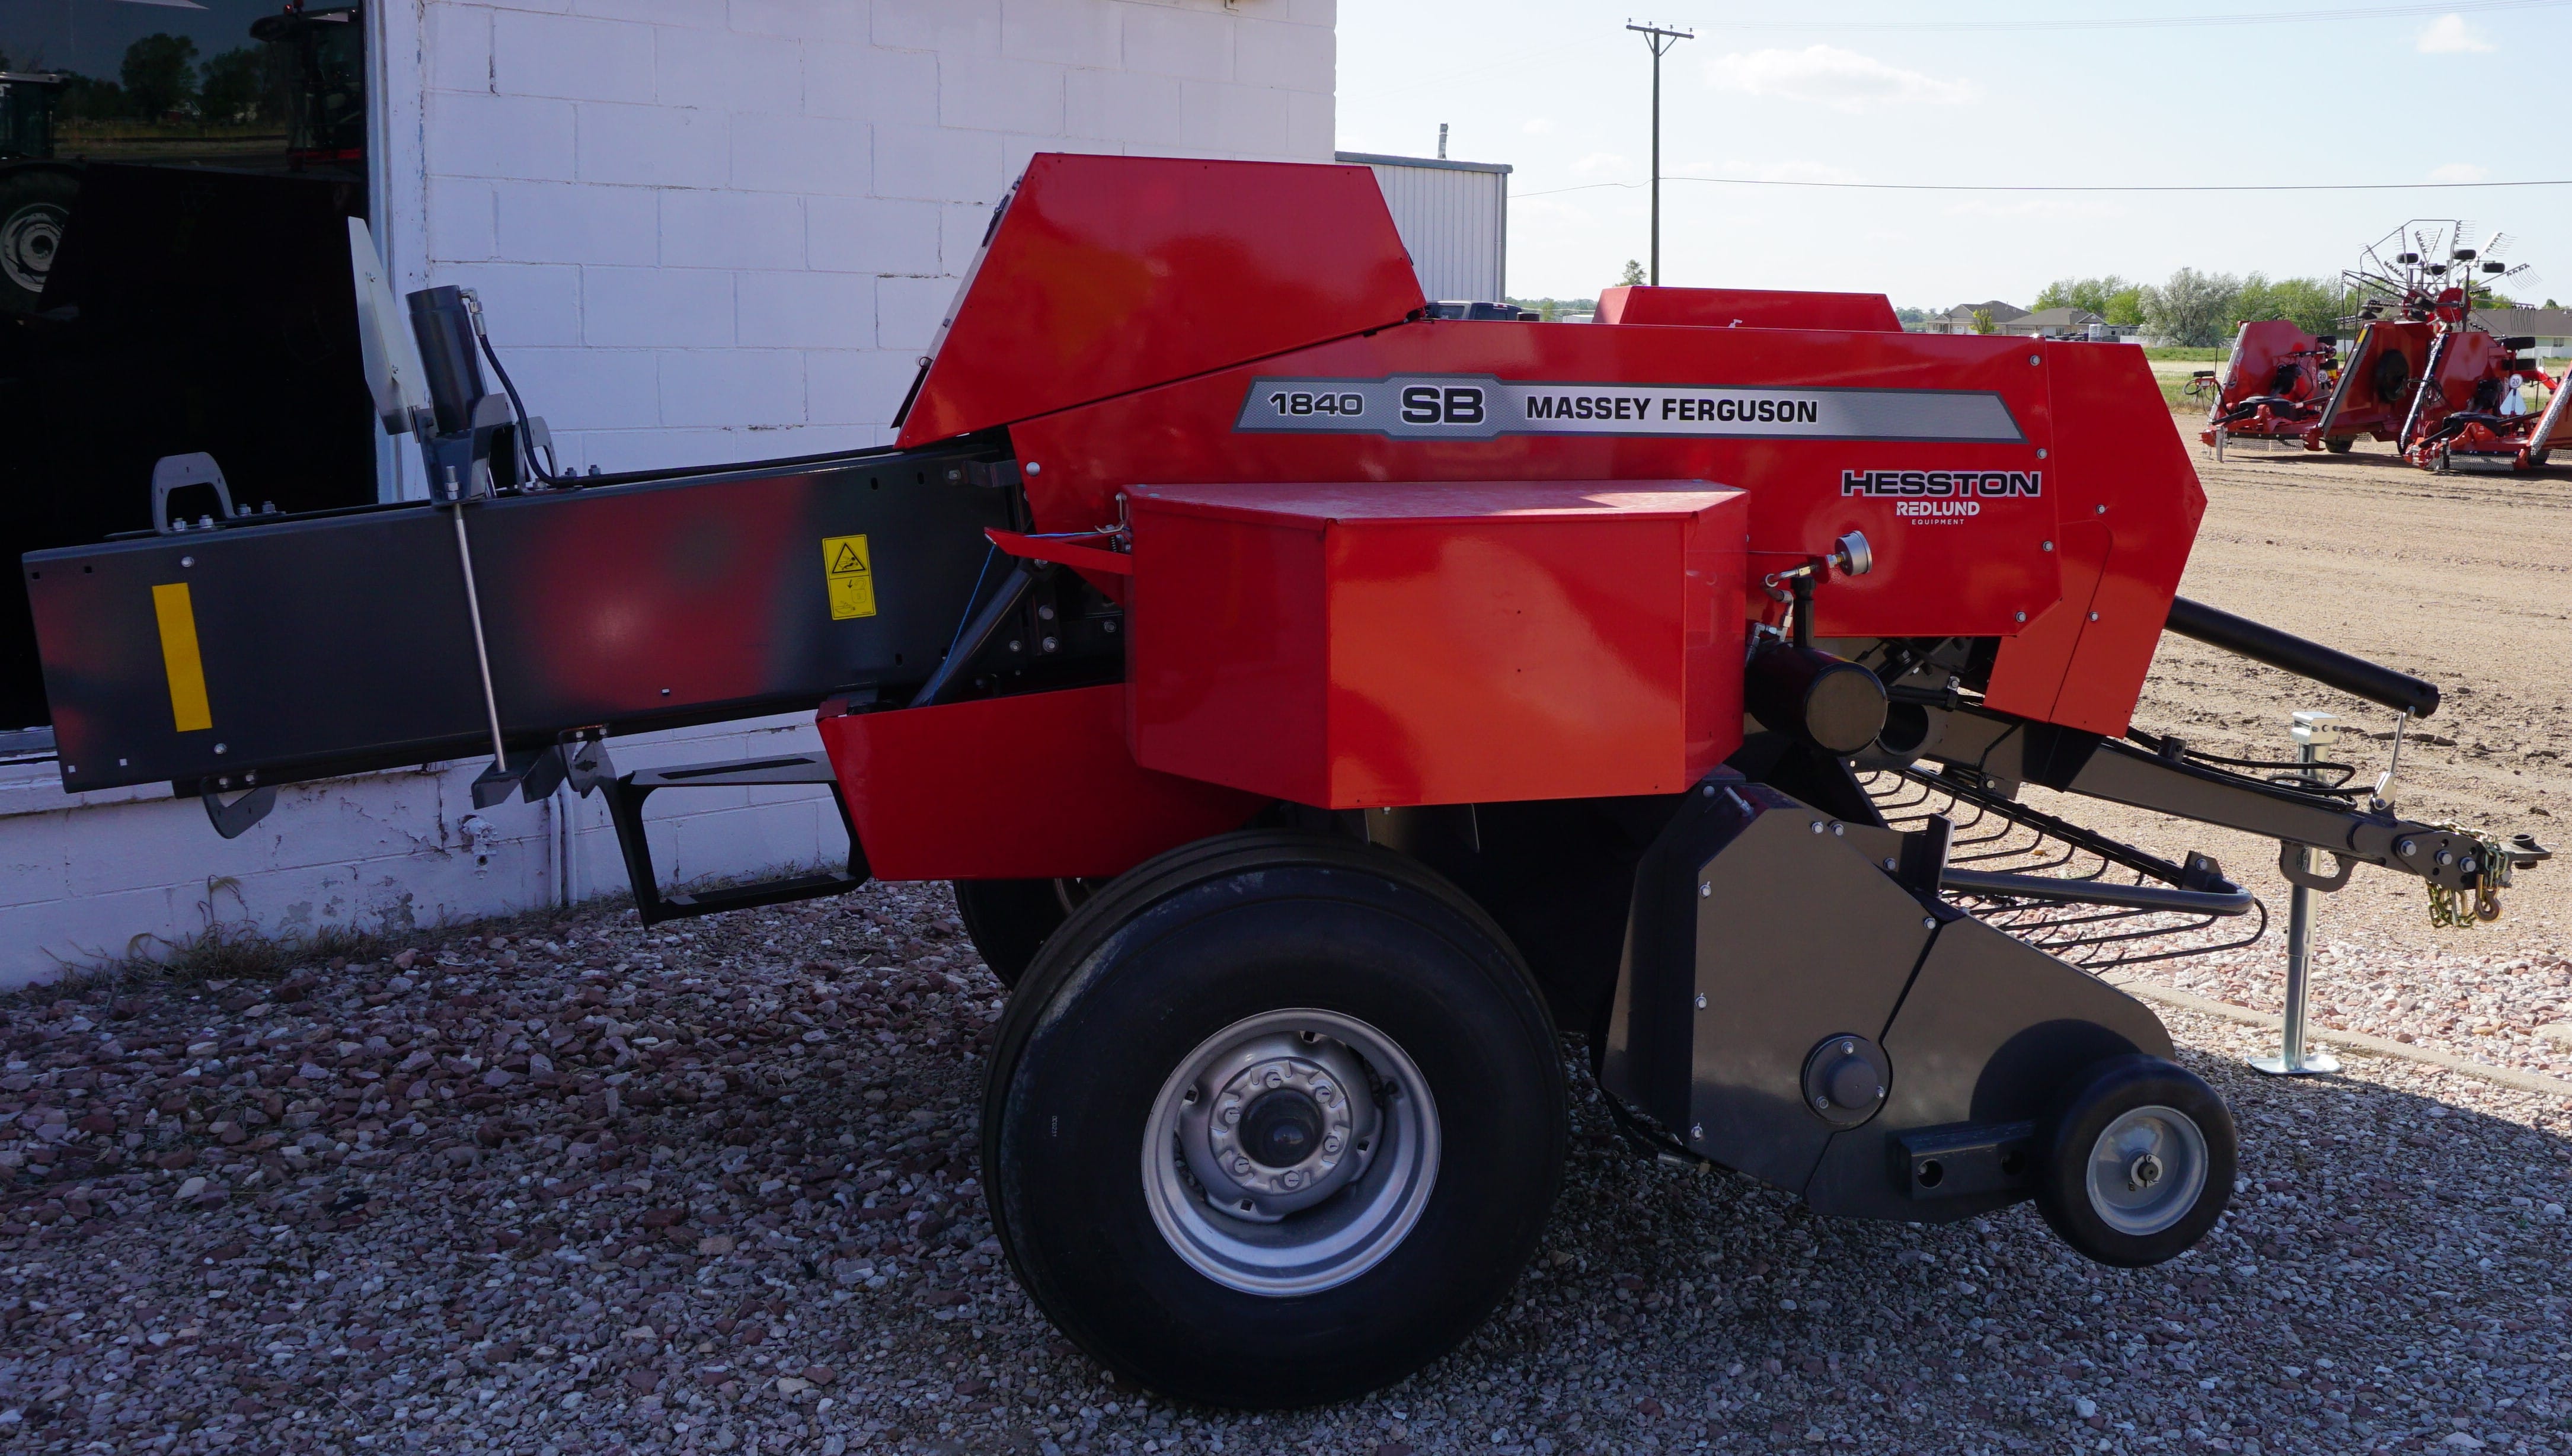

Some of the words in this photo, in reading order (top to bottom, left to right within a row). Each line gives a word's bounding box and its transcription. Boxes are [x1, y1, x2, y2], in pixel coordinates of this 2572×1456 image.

[1269, 392, 1363, 416] 1840
[1401, 385, 1485, 425] SB
[1526, 396, 1651, 420] MASSEY
[1662, 398, 1818, 423] FERGUSON
[1841, 470, 2041, 497] HESSTON
[1896, 501, 1980, 516] REDLUND
